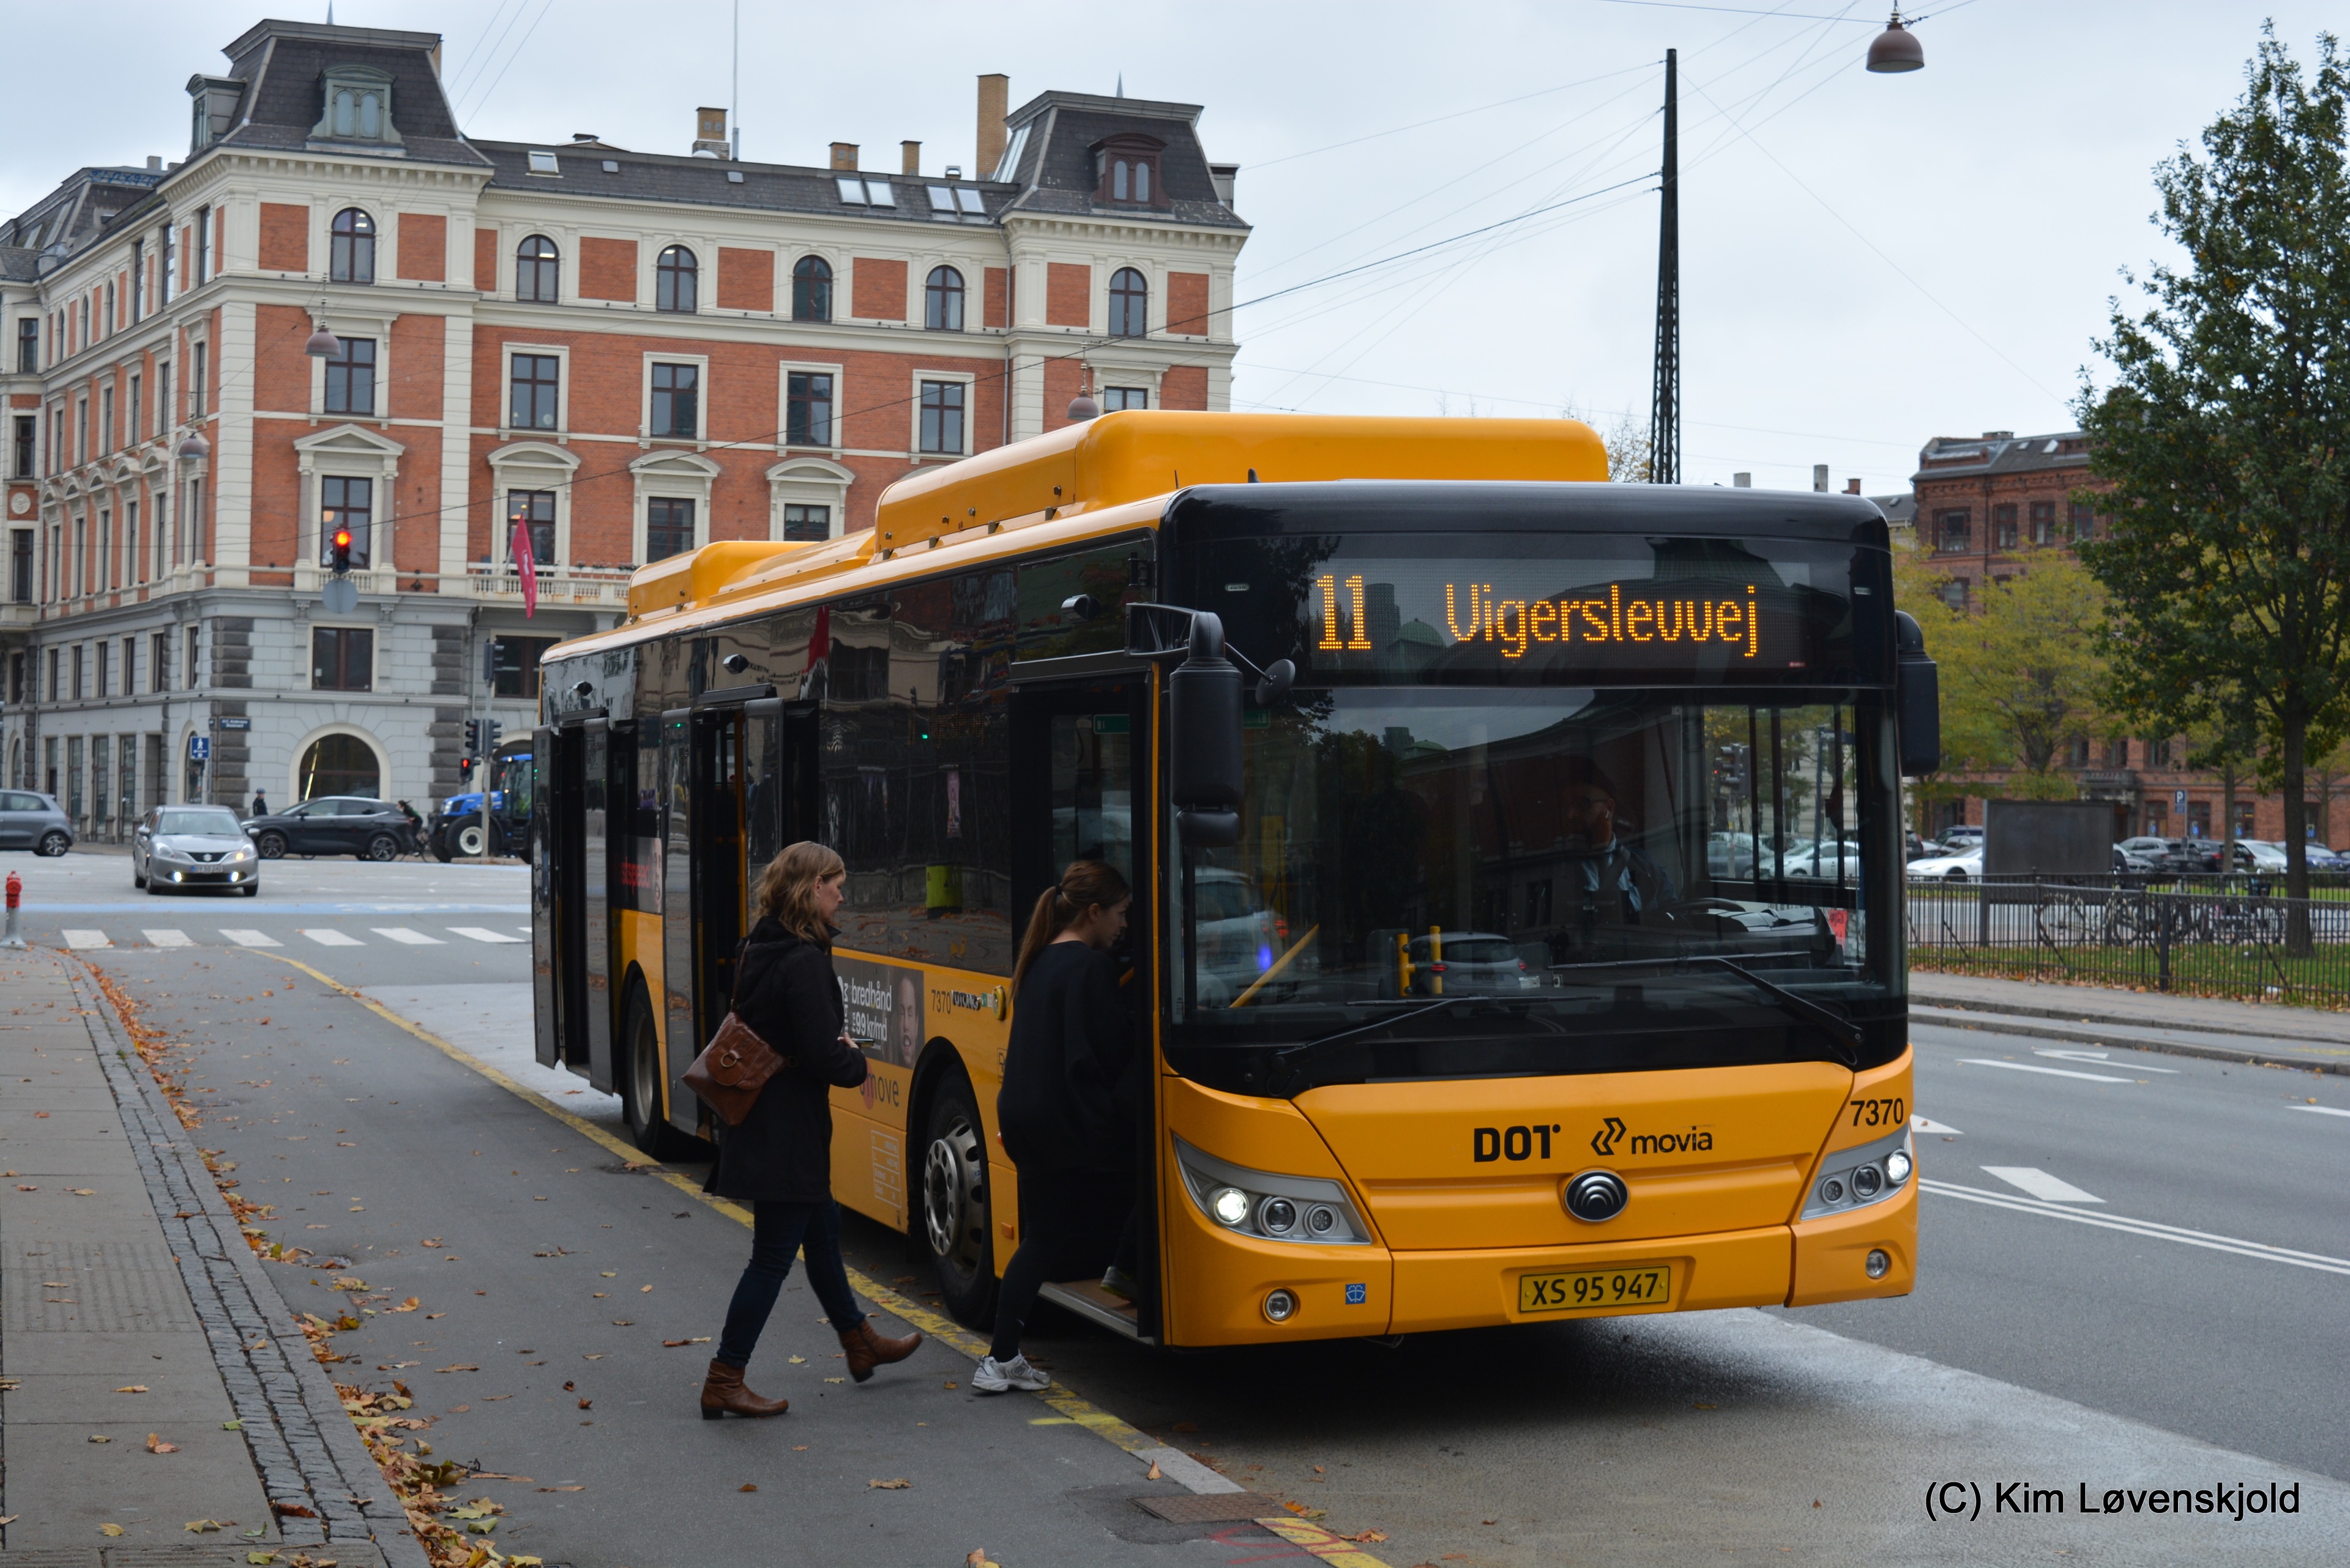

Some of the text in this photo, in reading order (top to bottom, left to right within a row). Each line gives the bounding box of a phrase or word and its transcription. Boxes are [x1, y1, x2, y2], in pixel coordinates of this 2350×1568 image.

[1316, 575, 1758, 658] 11 Vigerslevvej
[2176, 791, 2184, 803] P
[621, 856, 652, 896] stspeed
[851, 977, 892, 1012] bredbånd
[931, 989, 951, 1015] 7370
[856, 1012, 866, 1036] 99
[867, 1014, 887, 1041] kr/md
[1850, 1097, 1904, 1127] 7370
[1474, 1124, 1561, 1163] DOT
[1631, 1126, 1713, 1155] movia
[1531, 1273, 1659, 1306] XS 95 947
